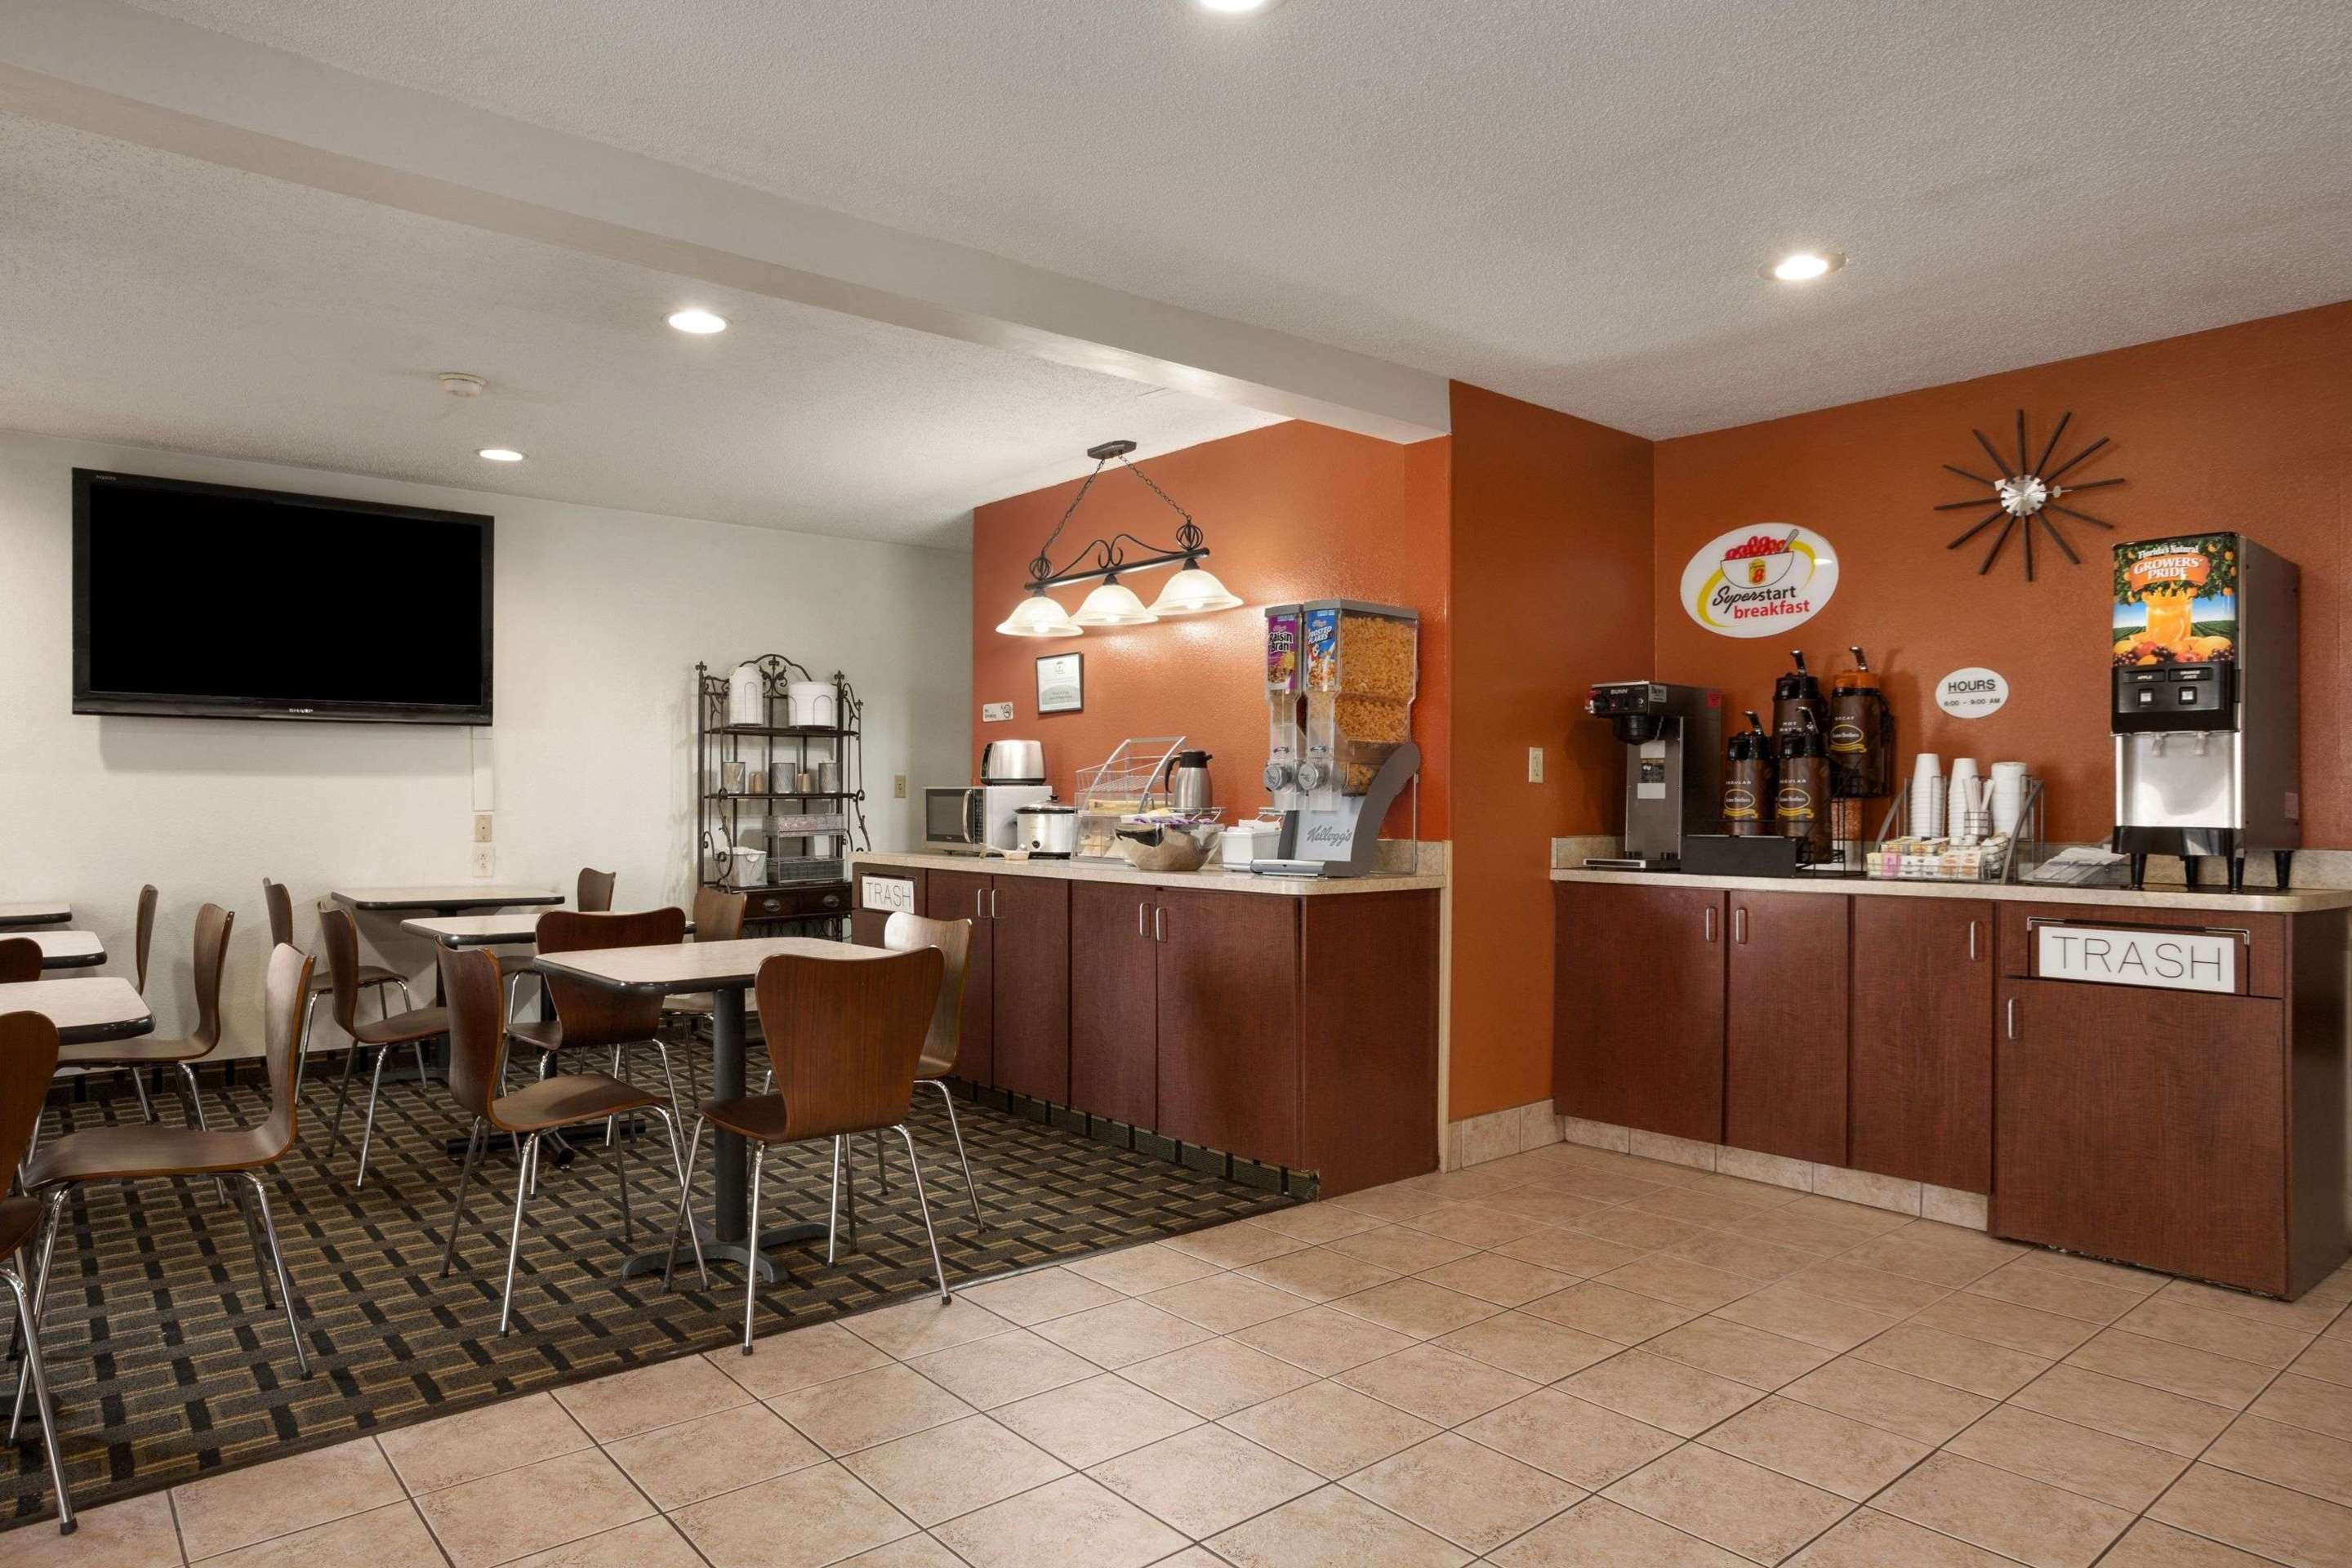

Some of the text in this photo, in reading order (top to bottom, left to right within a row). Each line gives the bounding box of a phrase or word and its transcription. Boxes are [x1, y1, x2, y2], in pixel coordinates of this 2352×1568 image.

[2148, 567, 2187, 581] PRIDE
[1712, 586, 1796, 614] Superstart
[1734, 599, 1811, 620] breakfast
[1268, 631, 1294, 643] Raisin
[1271, 641, 1290, 653] Bran
[1948, 679, 1996, 693] HOURS
[1306, 825, 1352, 847] Kellogg's
[866, 882, 911, 907] TRASH
[2051, 935, 2221, 982] TRASH
